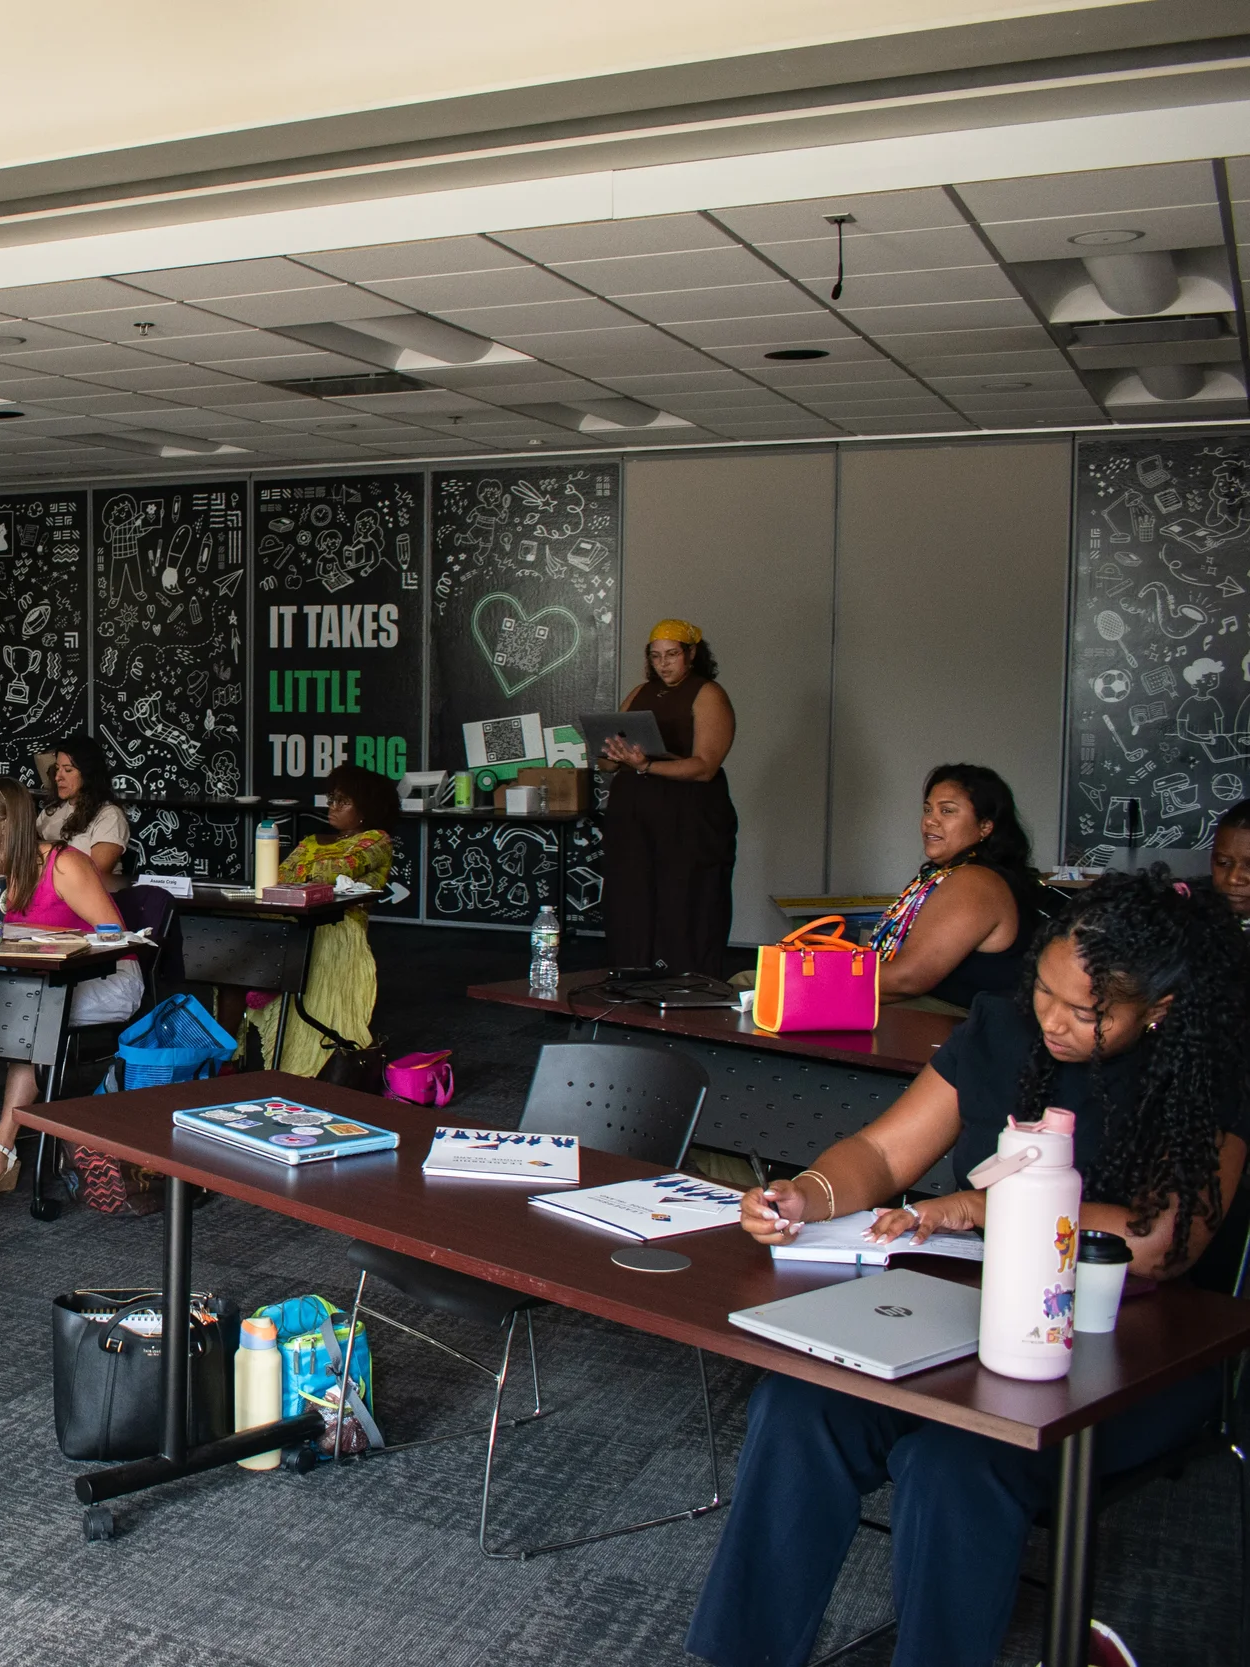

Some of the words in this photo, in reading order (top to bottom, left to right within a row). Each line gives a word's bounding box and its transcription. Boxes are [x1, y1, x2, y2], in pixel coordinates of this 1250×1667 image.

[269, 605, 298, 648] IT
[303, 603, 399, 648] TAKES
[269, 670, 361, 713] LITTLE
[269, 734, 306, 777] TO
[313, 734, 349, 778] BE
[355, 735, 407, 780] BIG
